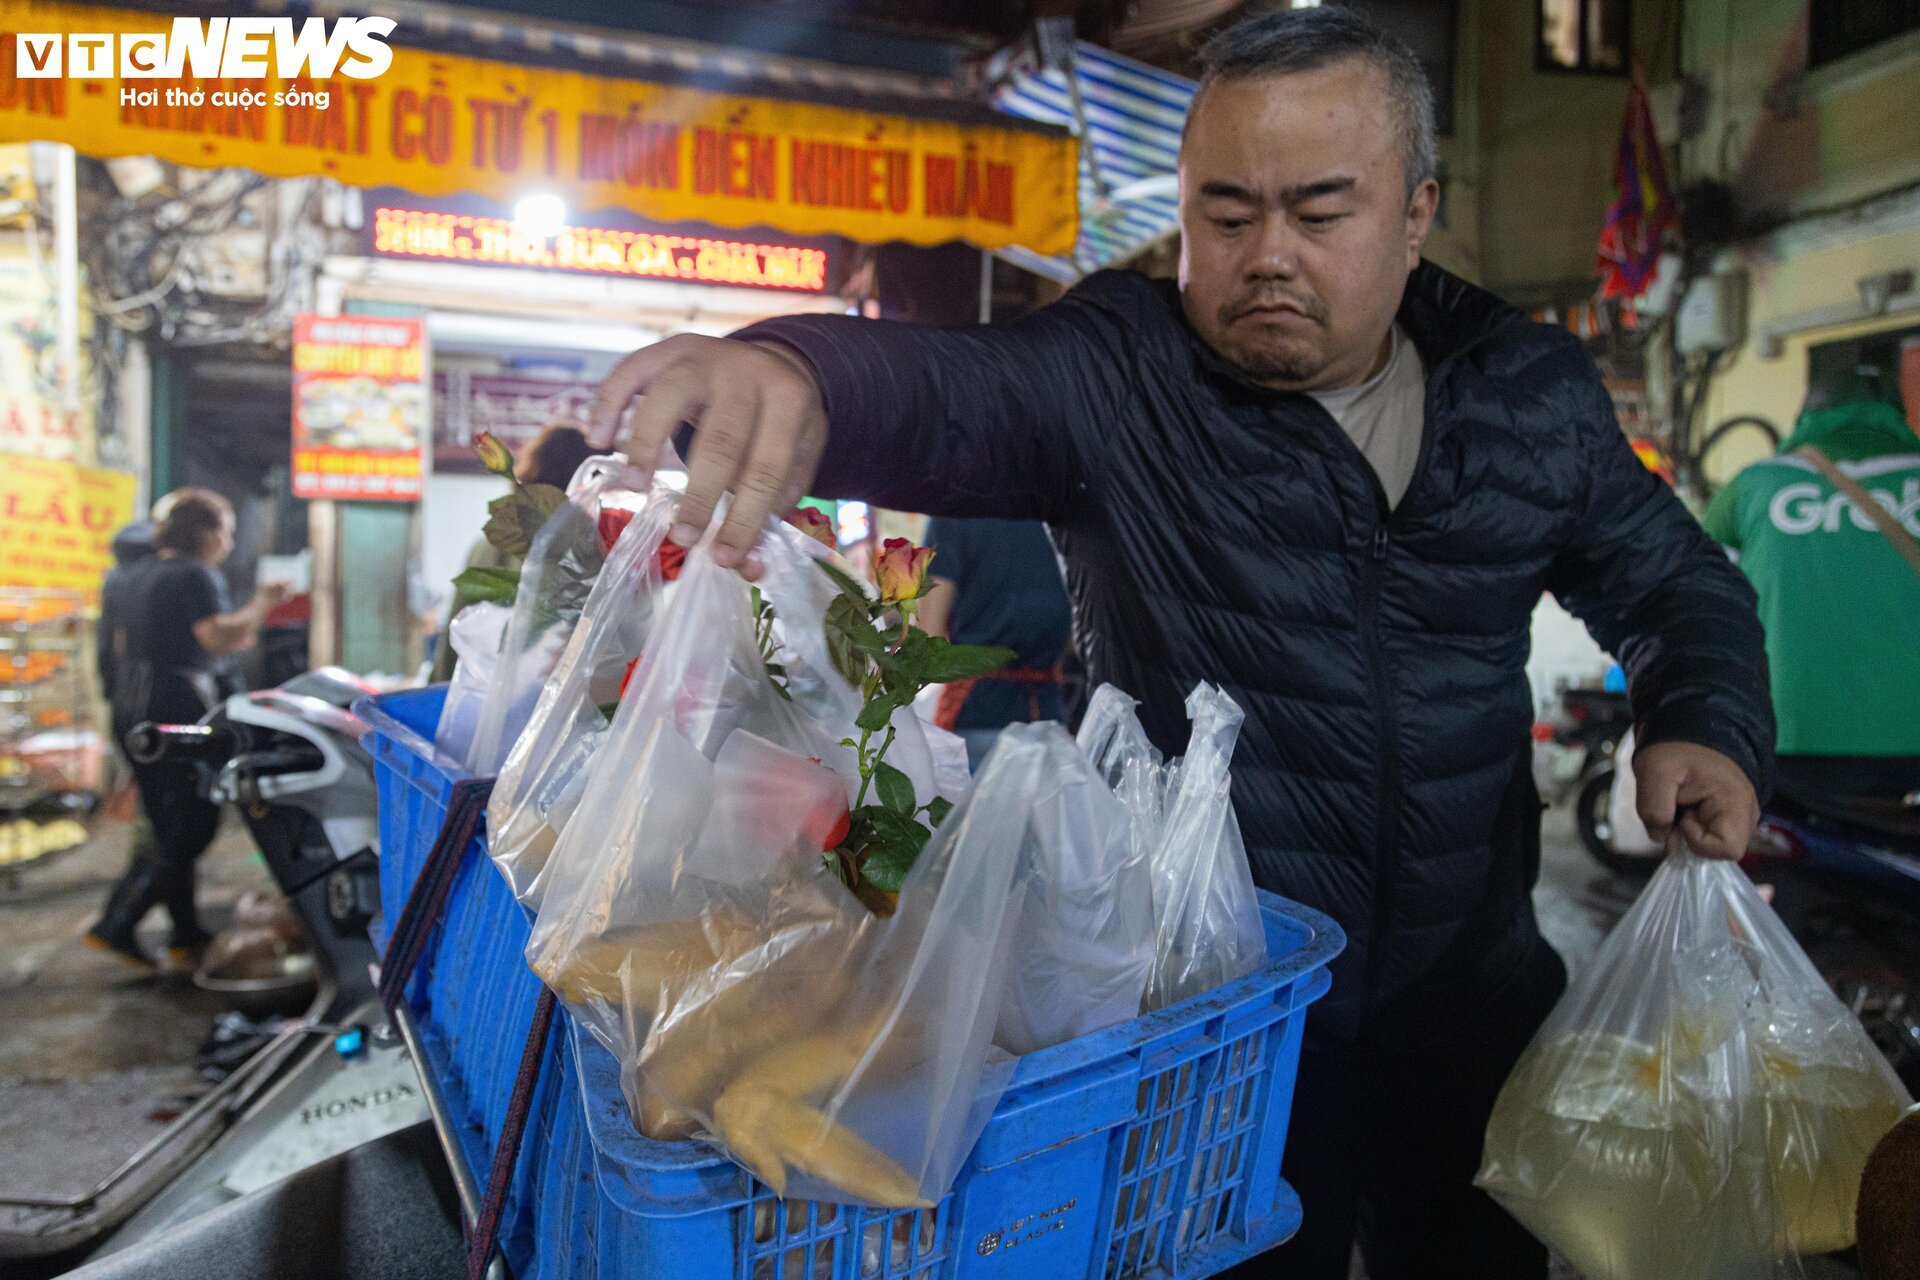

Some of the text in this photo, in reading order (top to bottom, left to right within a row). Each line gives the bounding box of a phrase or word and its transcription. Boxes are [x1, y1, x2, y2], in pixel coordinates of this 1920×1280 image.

[468, 82, 531, 172] TỪ
[539, 109, 558, 177] 1
[695, 104, 776, 202] ĐẾN
[302, 1083, 415, 1124] HONDA
